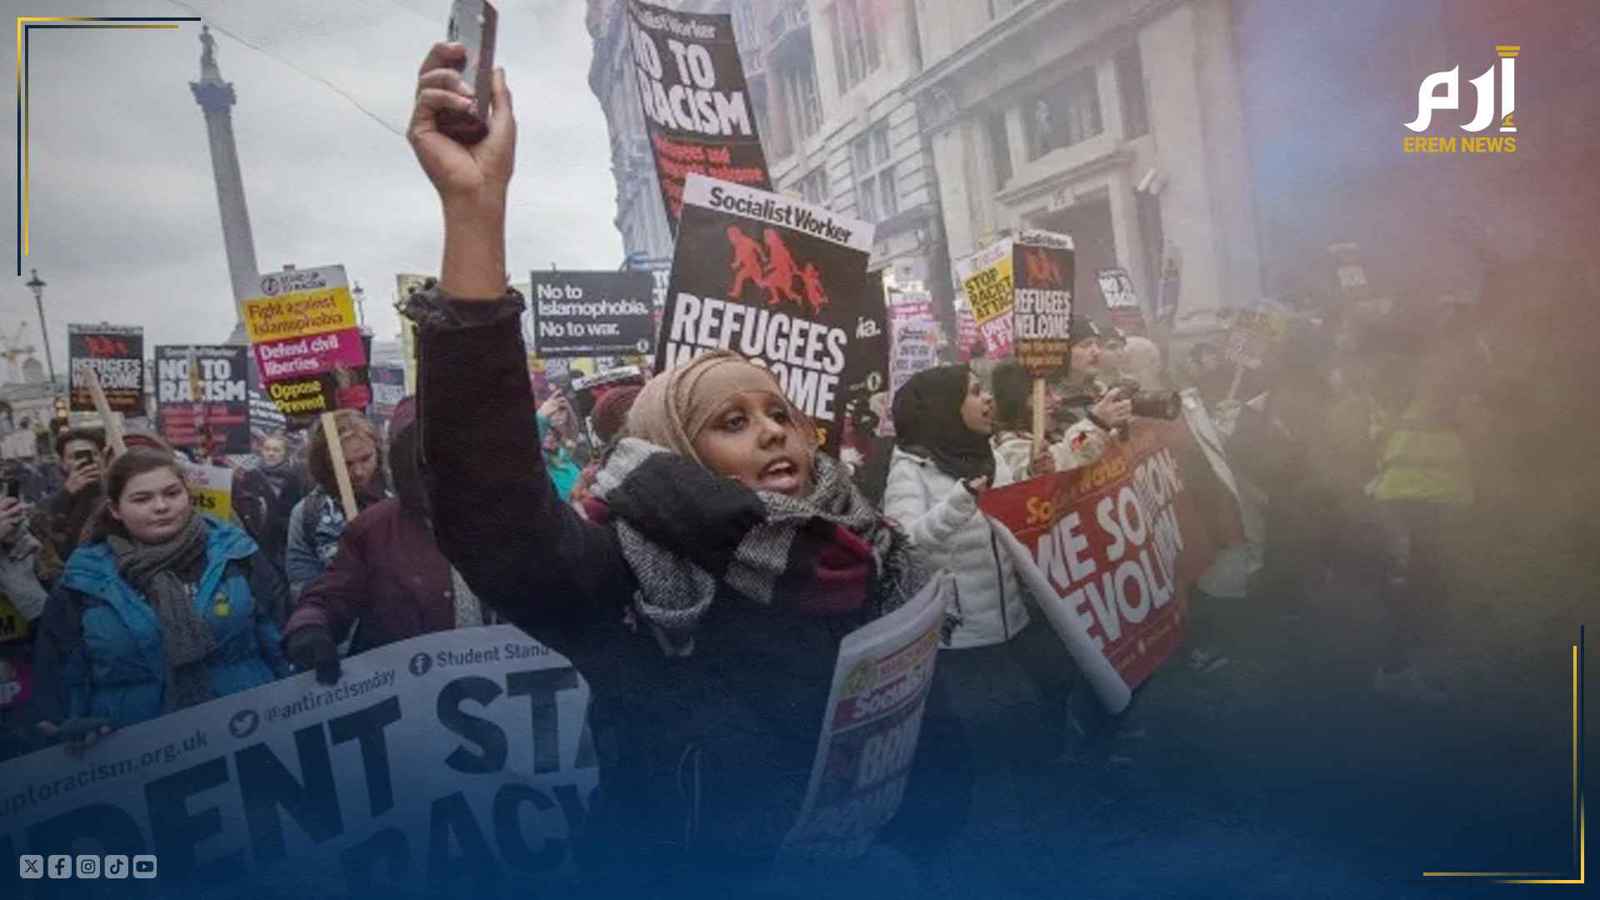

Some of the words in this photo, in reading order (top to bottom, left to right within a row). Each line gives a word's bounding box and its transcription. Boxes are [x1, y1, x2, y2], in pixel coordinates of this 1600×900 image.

[667, 39, 716, 89] TO
[709, 186, 792, 222] Socialist
[793, 206, 853, 244] Worker
[537, 284, 563, 299] No
[564, 285, 583, 299] to
[247, 303, 282, 321] Fight
[287, 295, 338, 313] against
[538, 300, 649, 318] Islamophobia.
[539, 322, 564, 337] No
[565, 322, 585, 337] to
[586, 323, 620, 336] war.
[670, 292, 848, 375] REFUGEES
[260, 339, 309, 361] Defend
[310, 334, 339, 351] civil
[202, 359, 232, 380] TO
[264, 358, 320, 376] liberties
[270, 381, 321, 400] Oppose
[435, 645, 501, 668] Student
